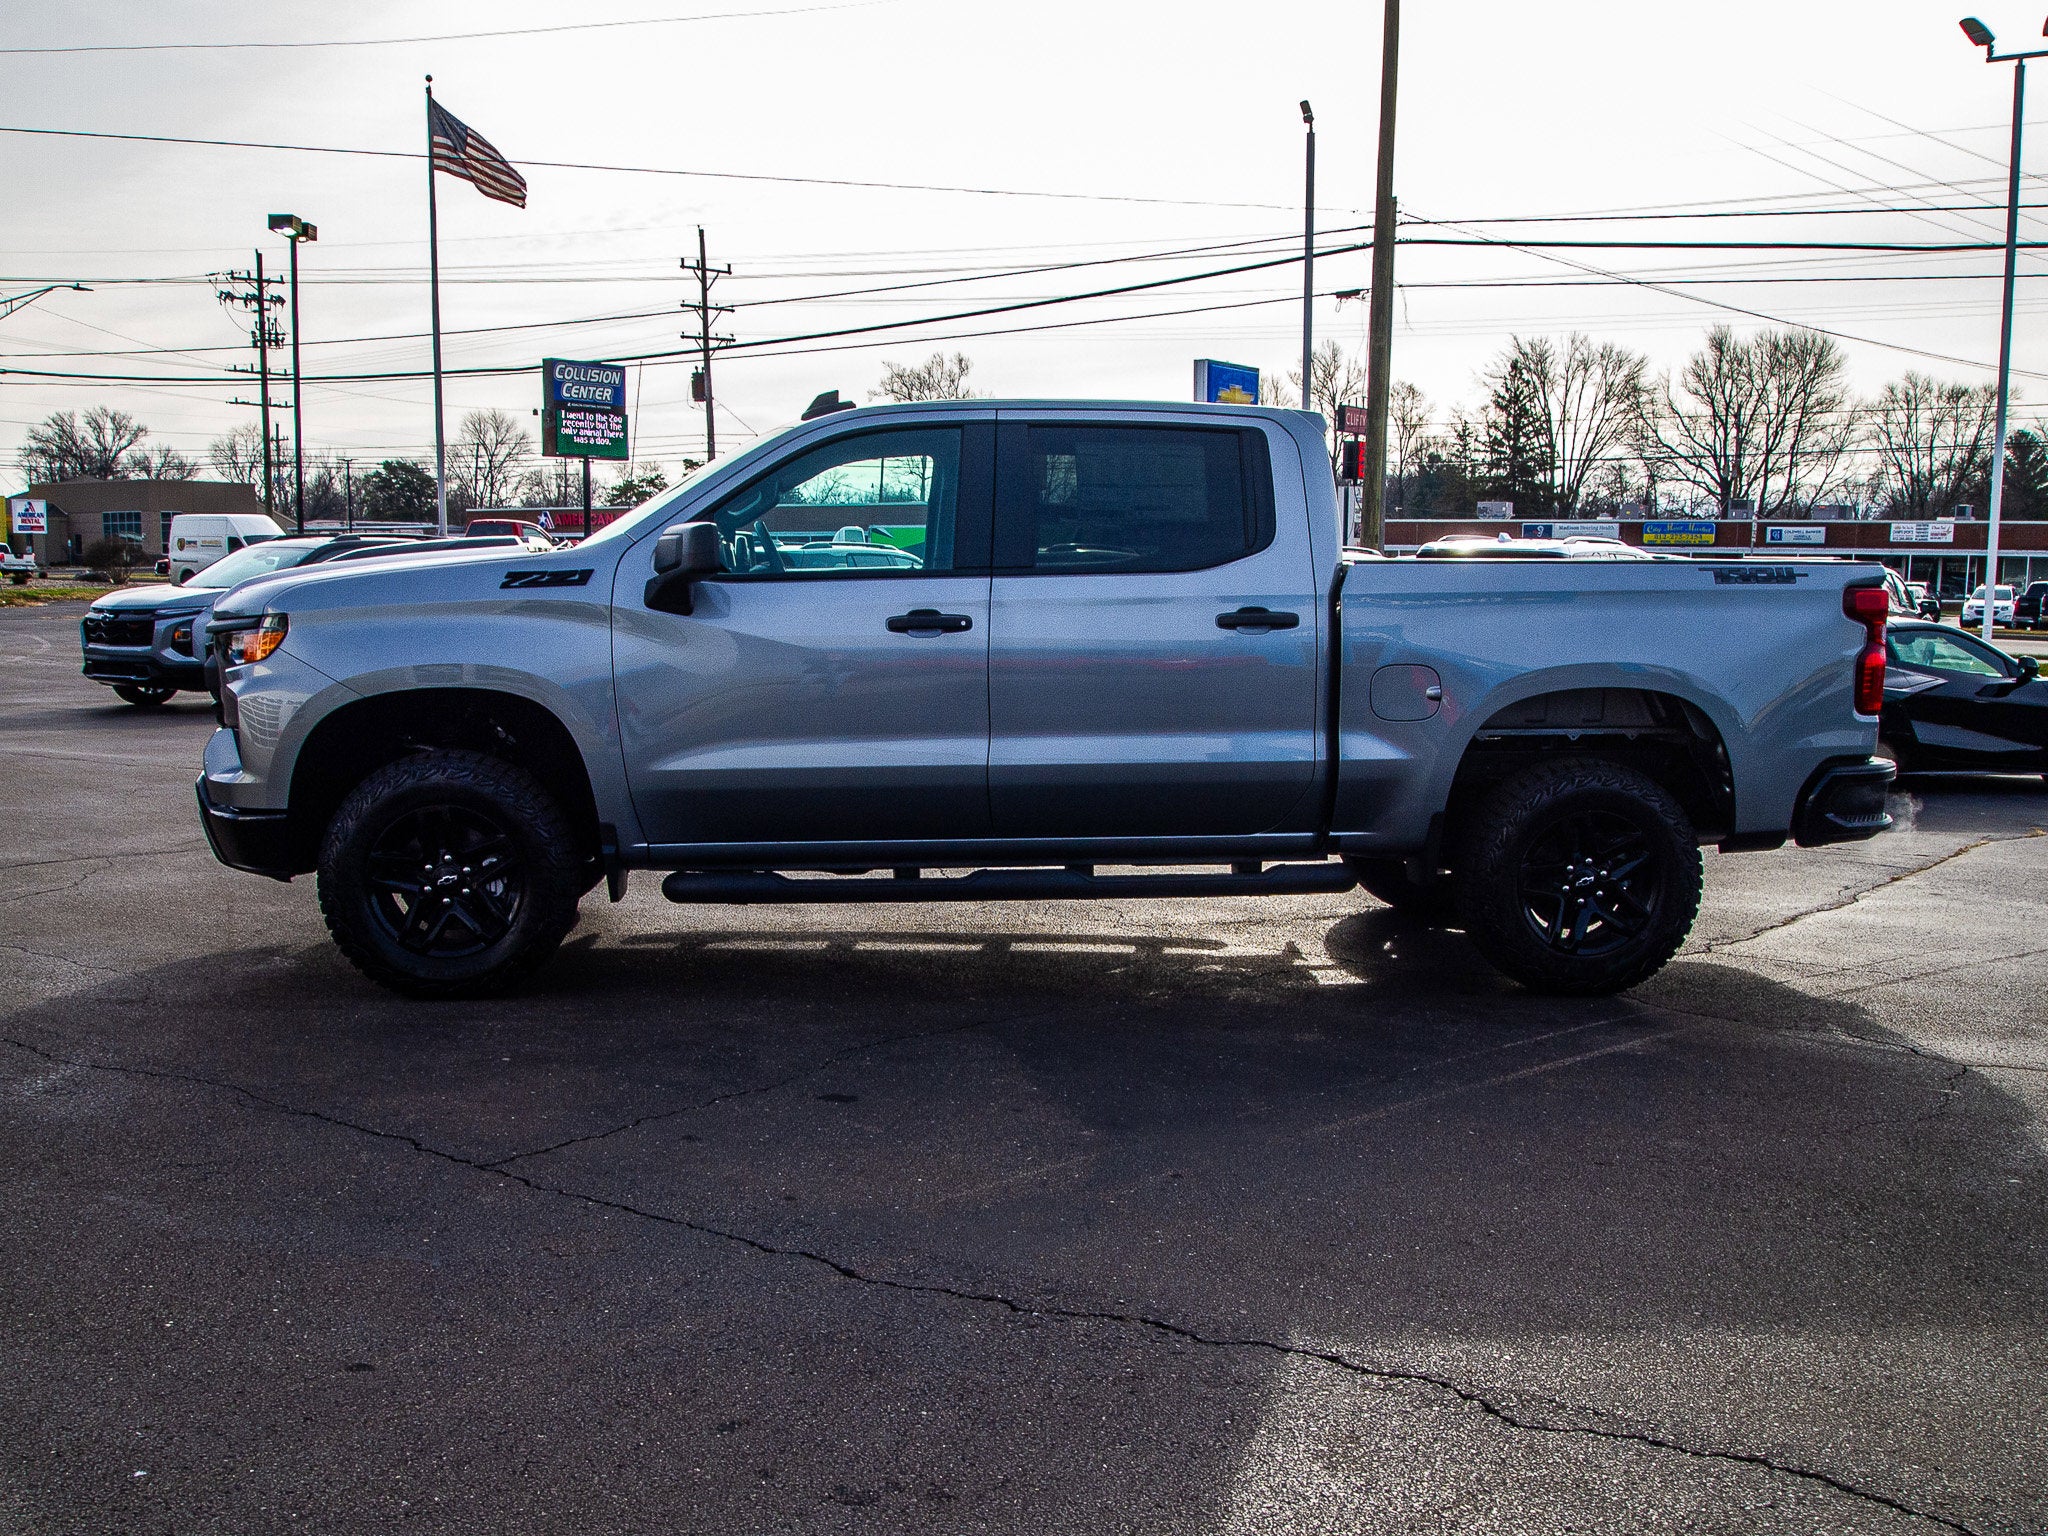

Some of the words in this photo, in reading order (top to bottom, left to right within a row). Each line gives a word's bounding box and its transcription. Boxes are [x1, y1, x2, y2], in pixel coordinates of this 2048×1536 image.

[561, 410, 565, 418] I
[566, 411, 584, 419] went
[586, 412, 594, 421] to
[596, 414, 608, 422] the
[609, 414, 622, 423] Zoo
[562, 420, 595, 429] recently
[596, 420, 608, 429] but
[610, 422, 623, 431] the
[561, 427, 578, 435] only
[579, 429, 602, 437] animal
[604, 430, 624, 438] there
[573, 436, 588, 444] was
[554, 513, 614, 525] AMERCAN
[499, 569, 595, 589] Z71
